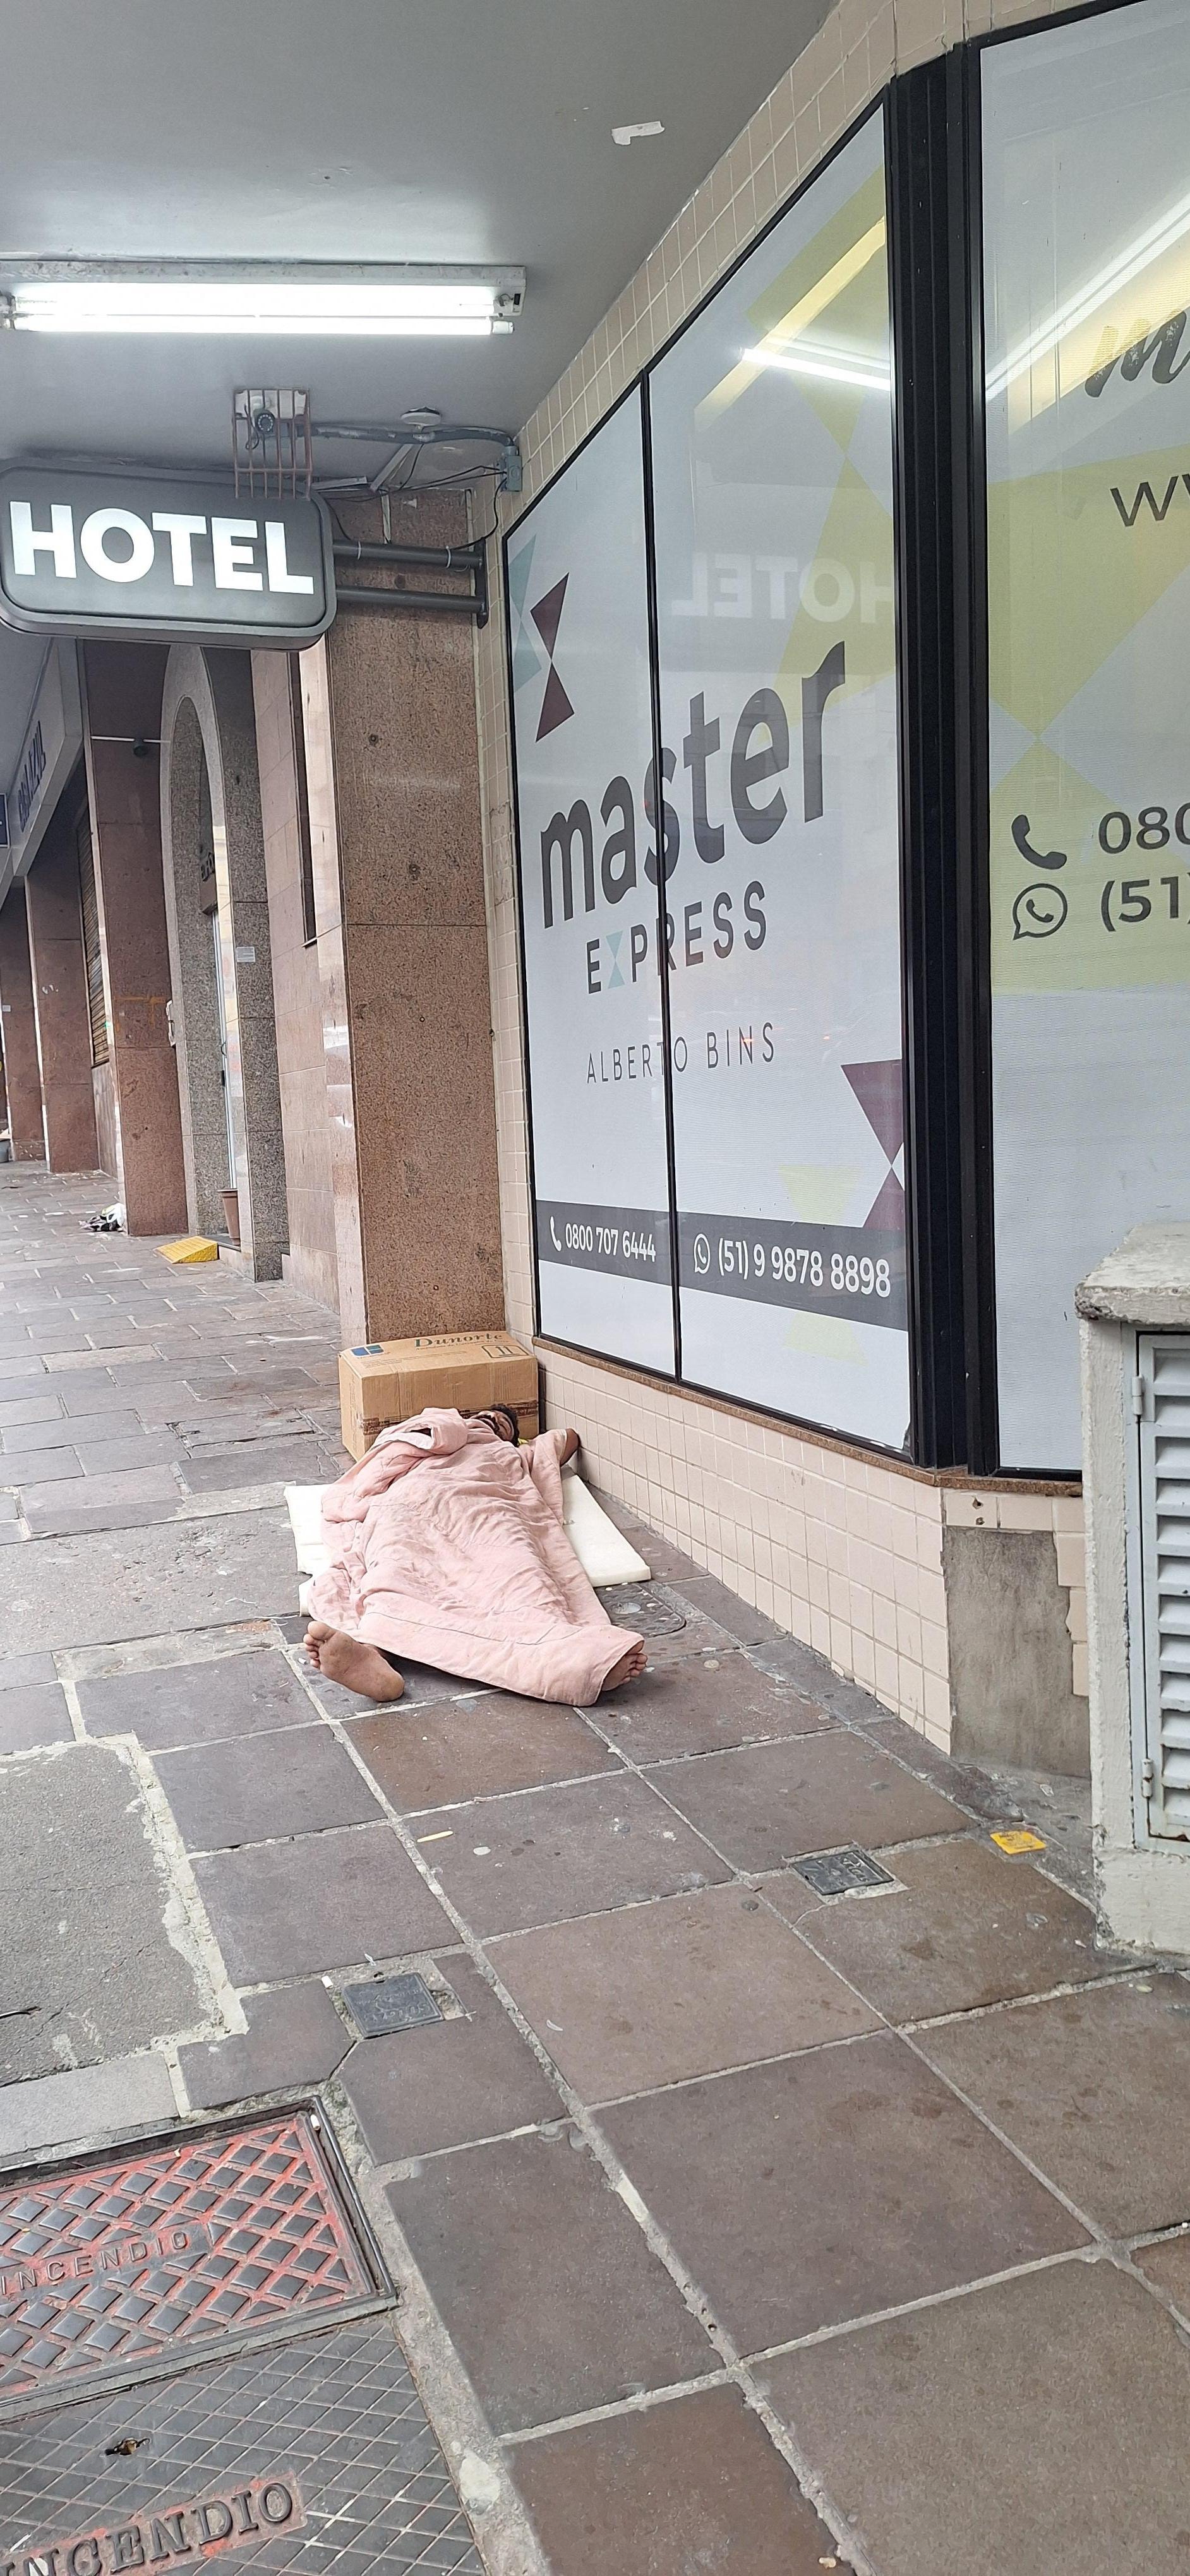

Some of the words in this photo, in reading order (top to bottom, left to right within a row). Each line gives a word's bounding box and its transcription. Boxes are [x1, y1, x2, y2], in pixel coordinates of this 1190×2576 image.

[9, 501, 314, 594] HOTEL
[541, 641, 845, 928] master
[1101, 872, 1190, 932] (51
[586, 880, 767, 994] EXPRESS
[587, 1036, 688, 1084] ALBERTO
[706, 1022, 774, 1069] BINS
[565, 1223, 593, 1251] 0800
[596, 1227, 618, 1256] 707
[622, 1231, 656, 1263] 6444
[718, 1237, 748, 1280] (51)
[753, 1243, 765, 1278] 9
[771, 1246, 824, 1287] 9878
[831, 1253, 891, 1298] 8898
[1, 2231, 188, 2296] INCENDIO
